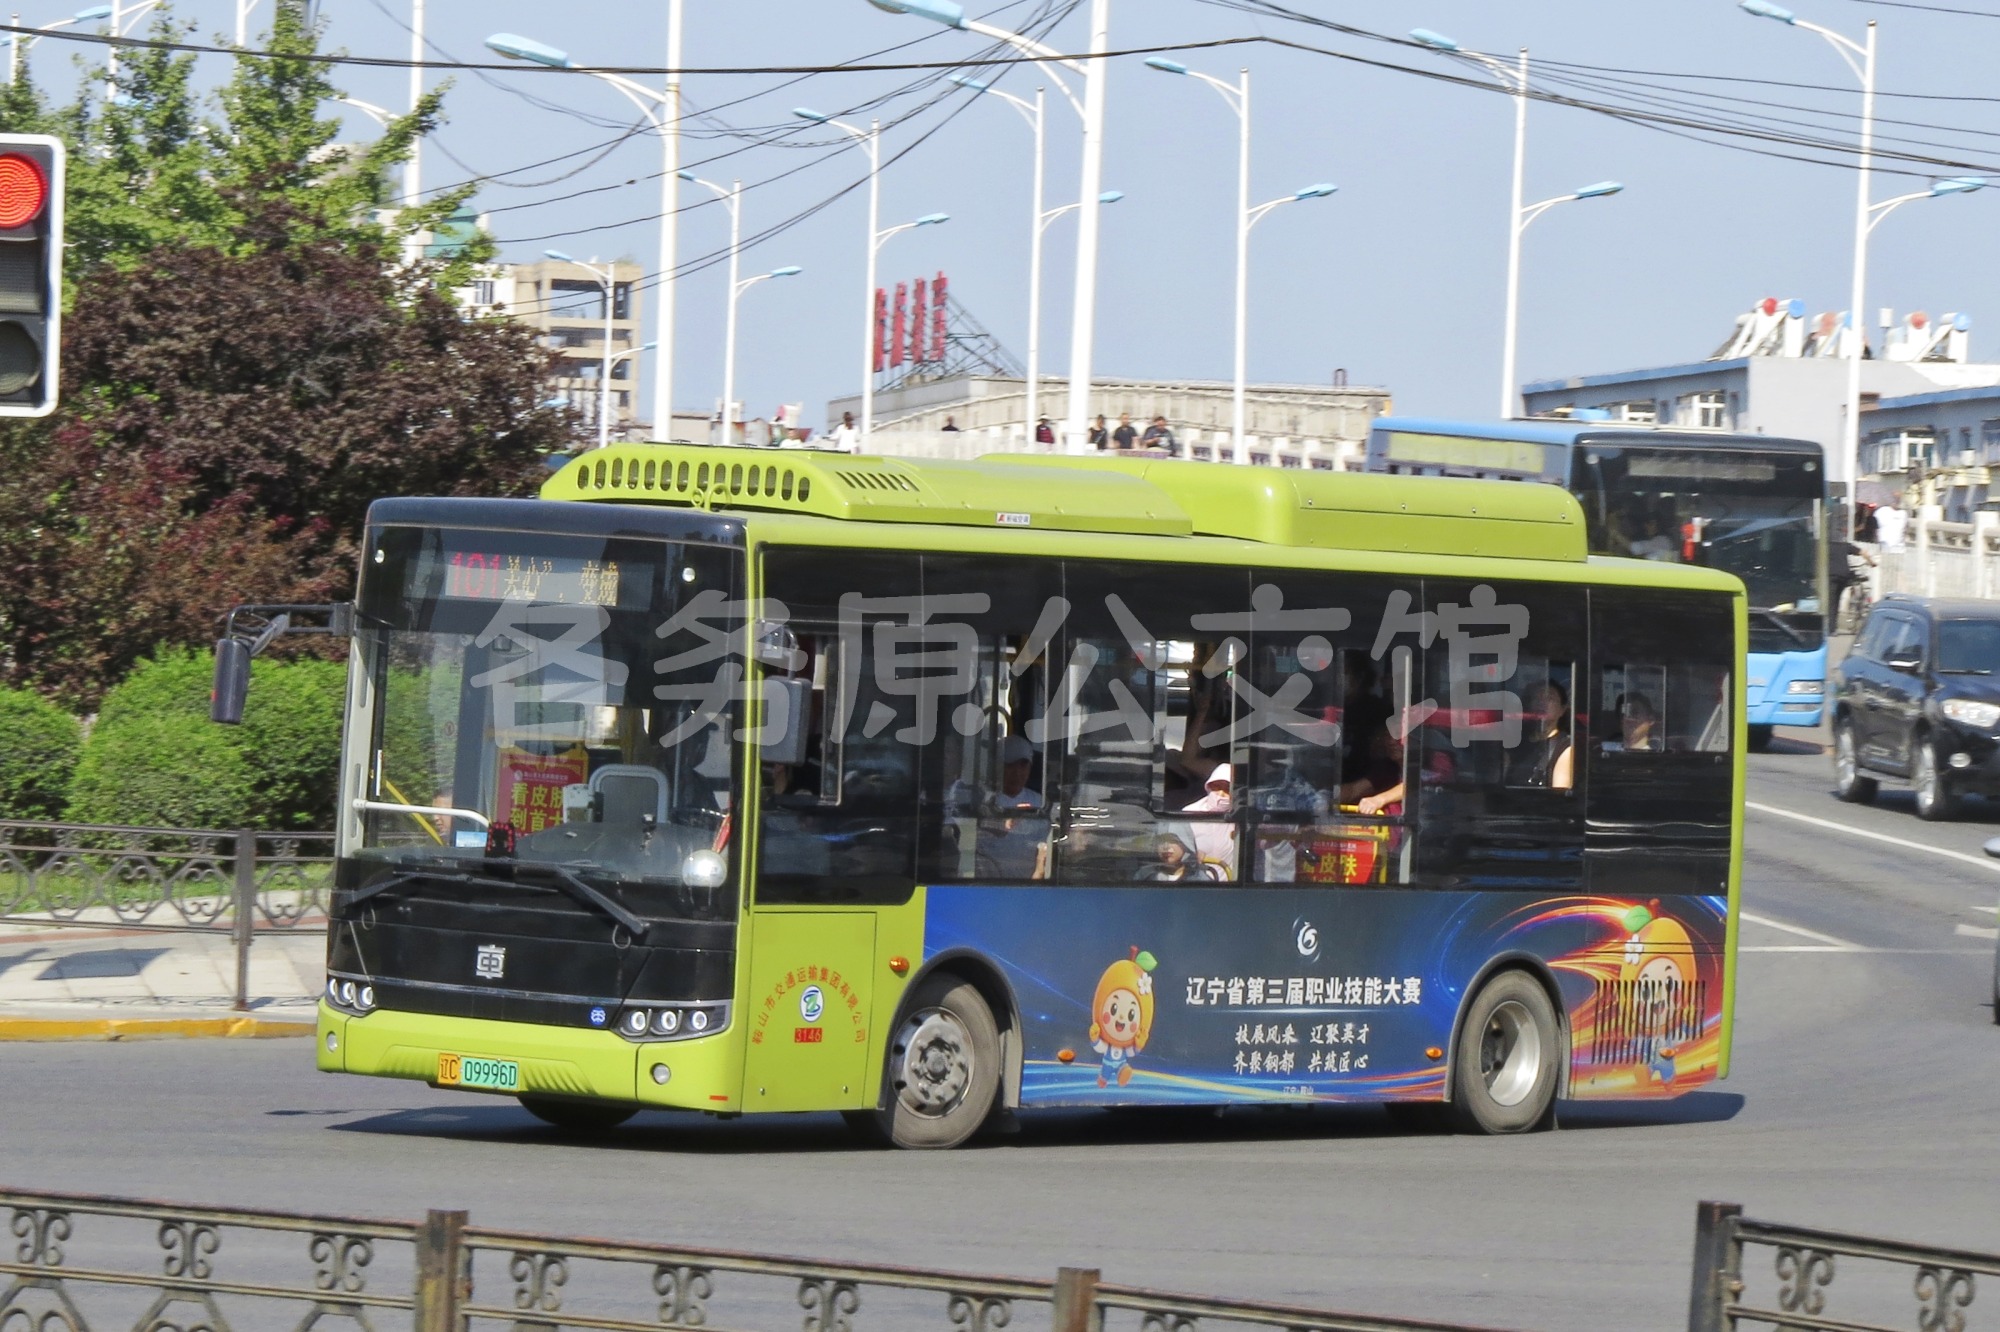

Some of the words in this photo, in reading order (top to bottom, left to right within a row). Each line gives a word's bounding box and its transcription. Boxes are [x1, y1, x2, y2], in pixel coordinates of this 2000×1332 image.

[452, 552, 501, 599] 101
[1186, 976, 1422, 1006] 辽宁省第三届职业技能大赛
[464, 1060, 517, 1087] 09996D
[1307, 1049, 1369, 1073] 共筑匠心
